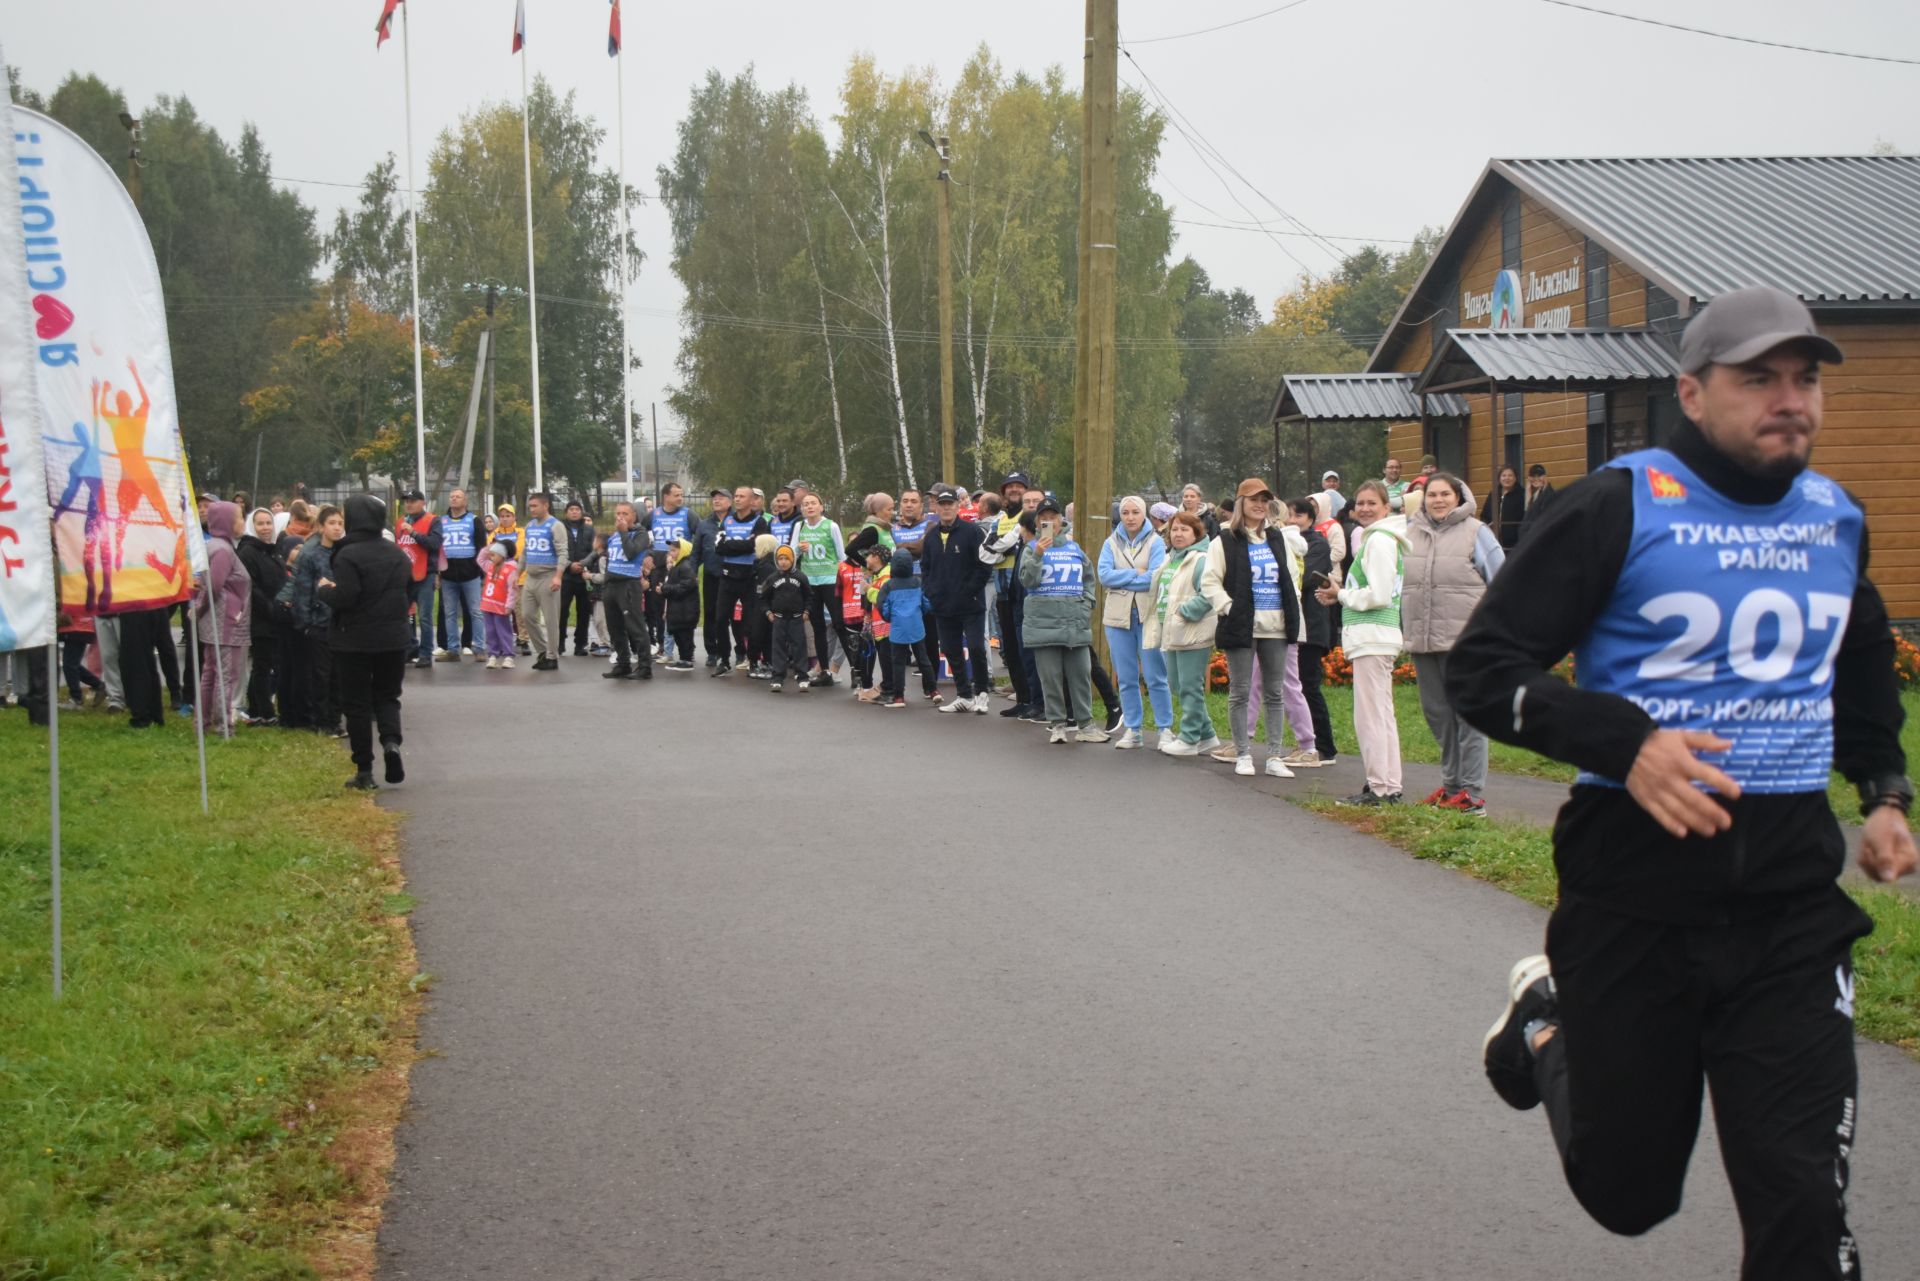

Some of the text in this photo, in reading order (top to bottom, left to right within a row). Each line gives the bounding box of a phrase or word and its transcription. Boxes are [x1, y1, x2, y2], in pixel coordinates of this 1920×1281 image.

[1526, 256, 1580, 303] Лыжный
[39, 343, 79, 368] Я
[443, 532, 471, 546] 213
[526, 537, 550, 552] 08
[653, 527, 685, 541] 216
[1669, 522, 1837, 547] ТУКАЕВСКИЙ
[1718, 543, 1808, 572] РАЙОН
[1040, 563, 1083, 584] 277
[485, 583, 495, 596] 8
[1636, 587, 1851, 686] 207
